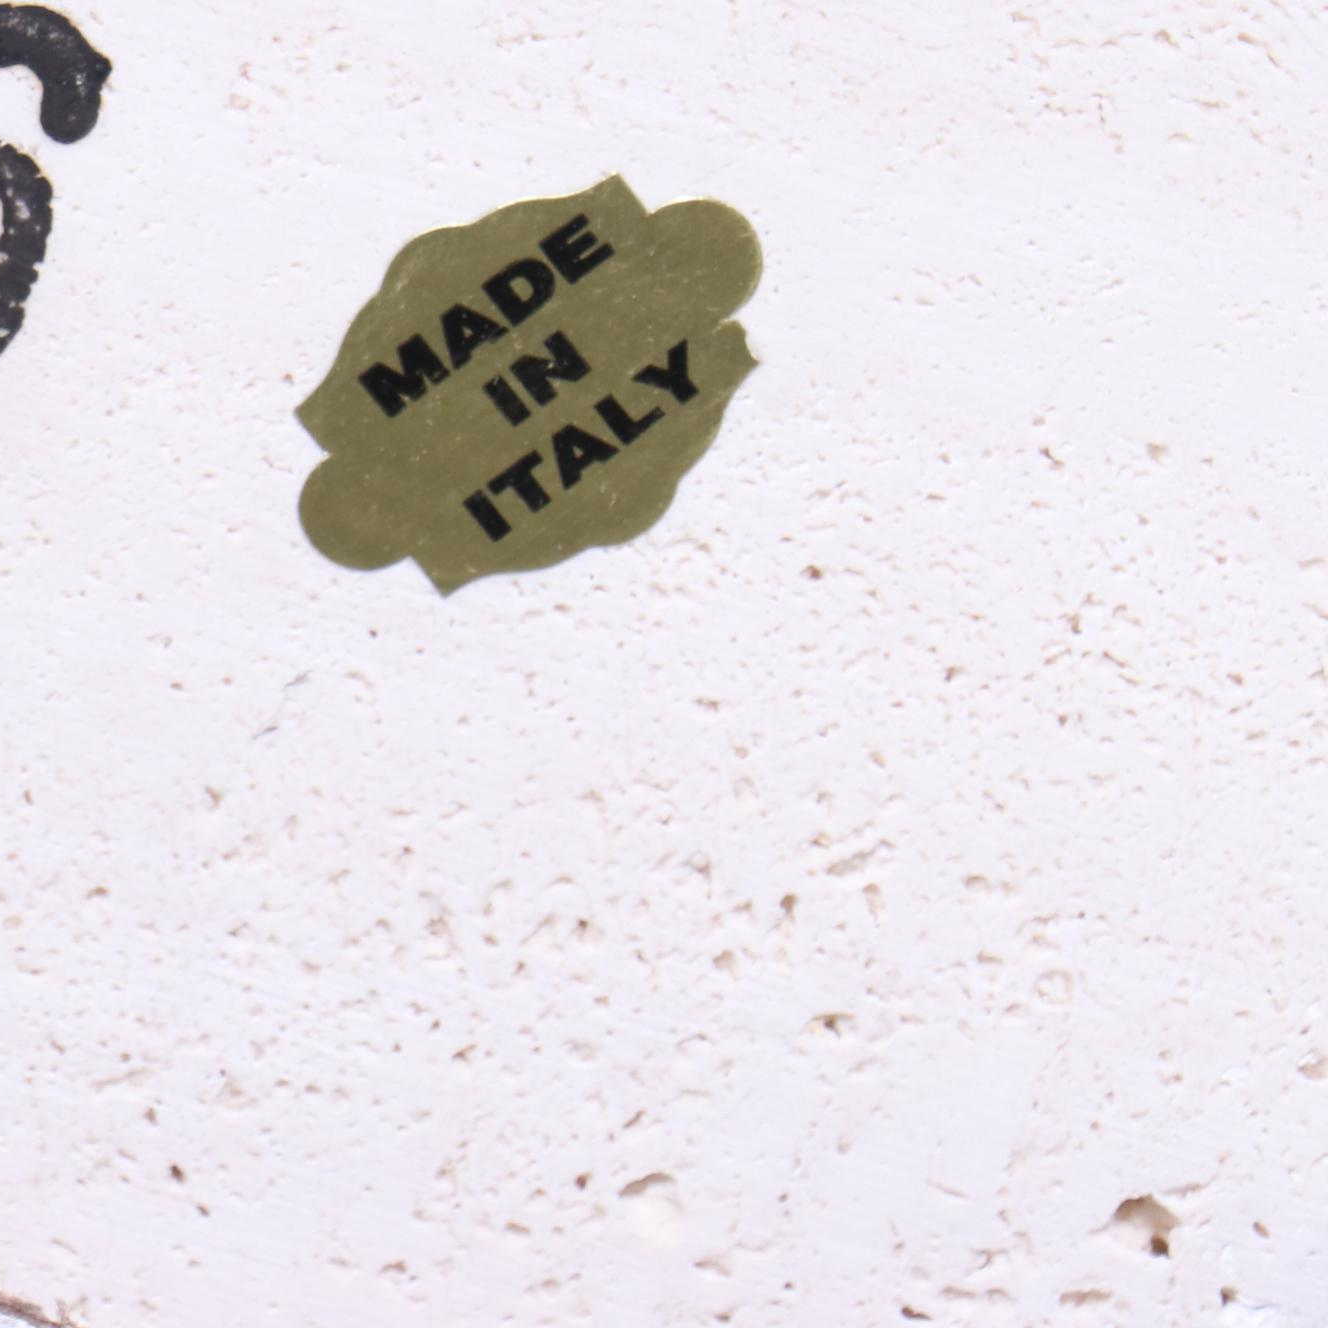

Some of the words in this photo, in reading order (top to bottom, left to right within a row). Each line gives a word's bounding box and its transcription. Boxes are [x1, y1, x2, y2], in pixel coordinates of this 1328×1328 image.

[357, 213, 616, 418] MADE
[482, 330, 592, 427] IN
[462, 339, 700, 542] ITALY
